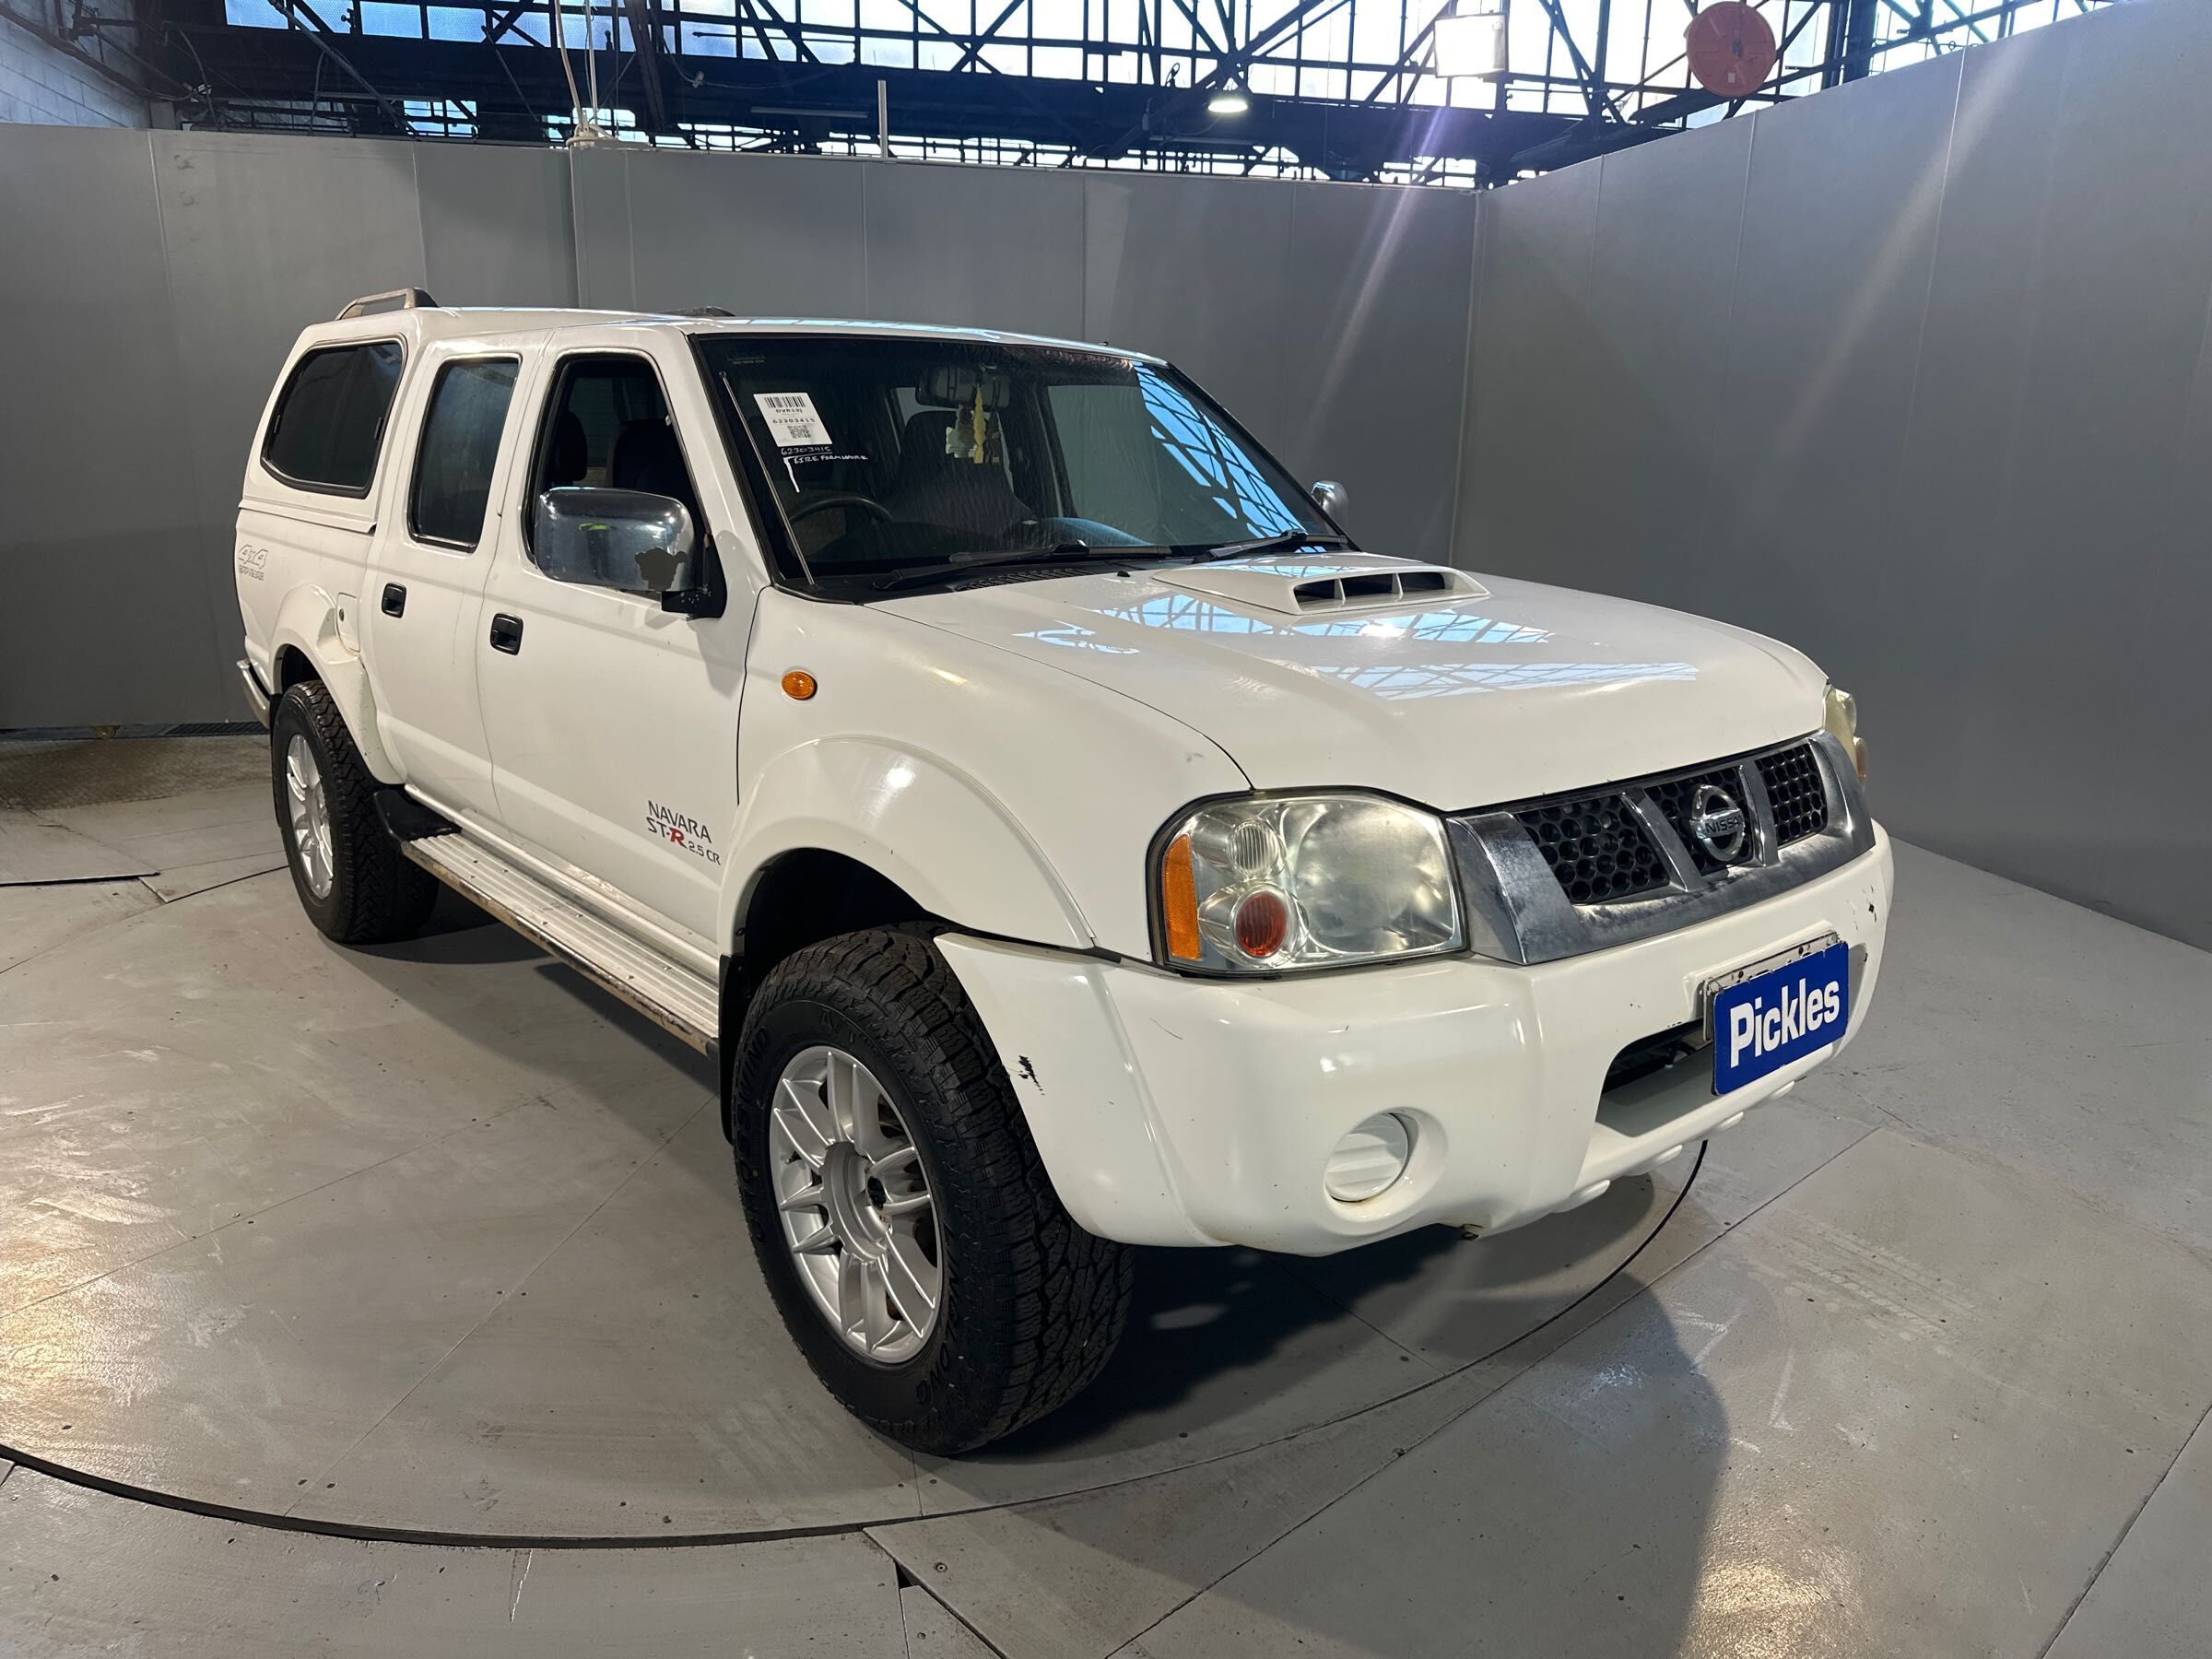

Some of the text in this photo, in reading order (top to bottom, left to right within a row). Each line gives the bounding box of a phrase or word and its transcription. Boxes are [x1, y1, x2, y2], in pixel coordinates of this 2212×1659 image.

[781, 446, 831, 455] 62303415
[646, 817, 721, 865] ST-R 2.5 CR
[648, 799, 712, 843] NAVARA
[1705, 815, 1744, 833] NISSAN
[1730, 978, 1841, 1068] Pickles
